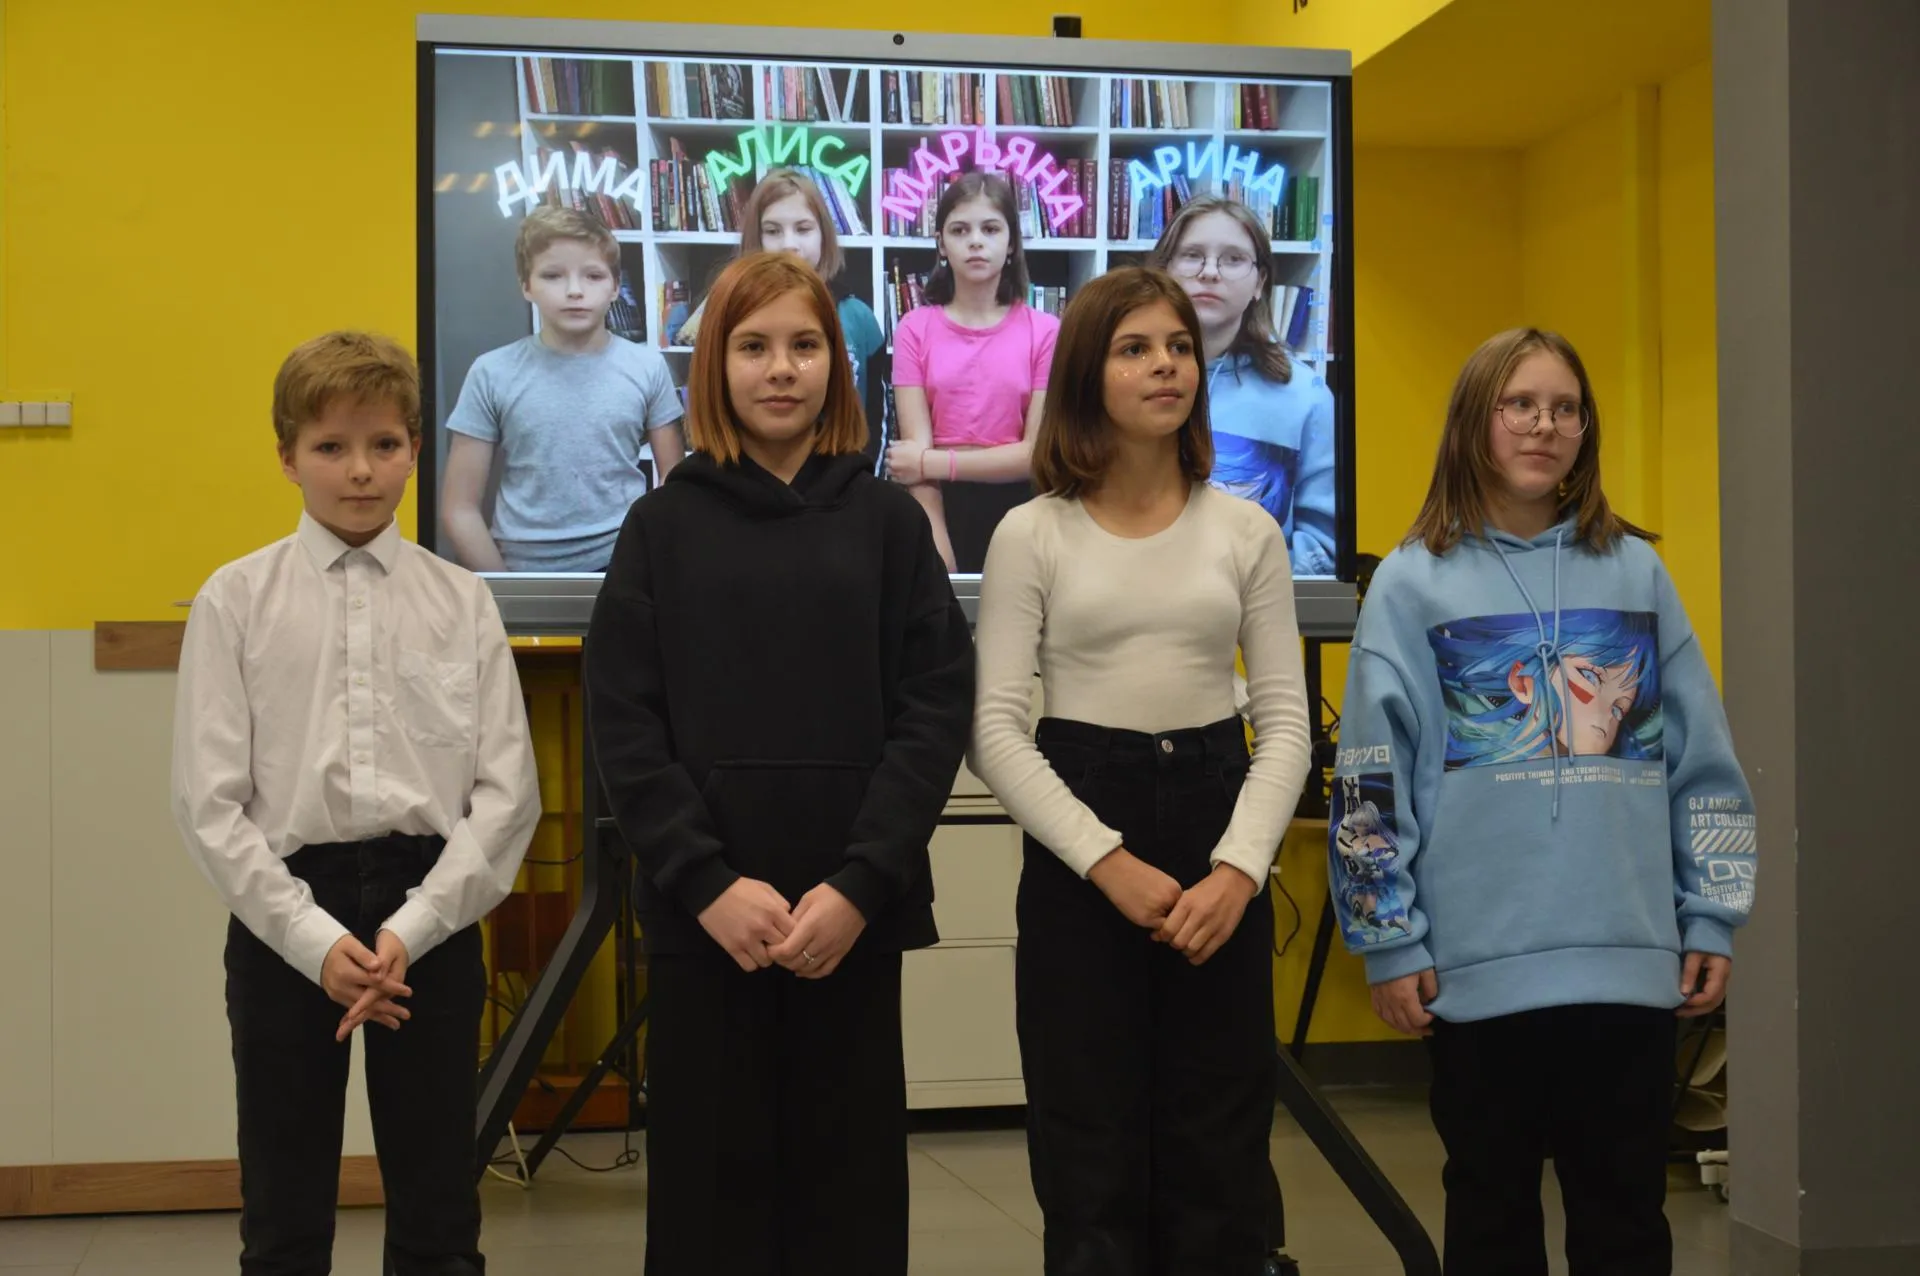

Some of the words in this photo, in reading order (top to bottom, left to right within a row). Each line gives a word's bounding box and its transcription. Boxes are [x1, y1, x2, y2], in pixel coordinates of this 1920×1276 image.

[494, 151, 648, 218] ДИМА
[705, 124, 870, 196] АЛИСА
[882, 126, 1082, 230] МАРЬЯНА
[1127, 141, 1288, 204] АРИНА
[1495, 771, 1526, 782] POSITIVE
[1528, 769, 1556, 779] THINKIN
[1690, 814, 1711, 828] ART
